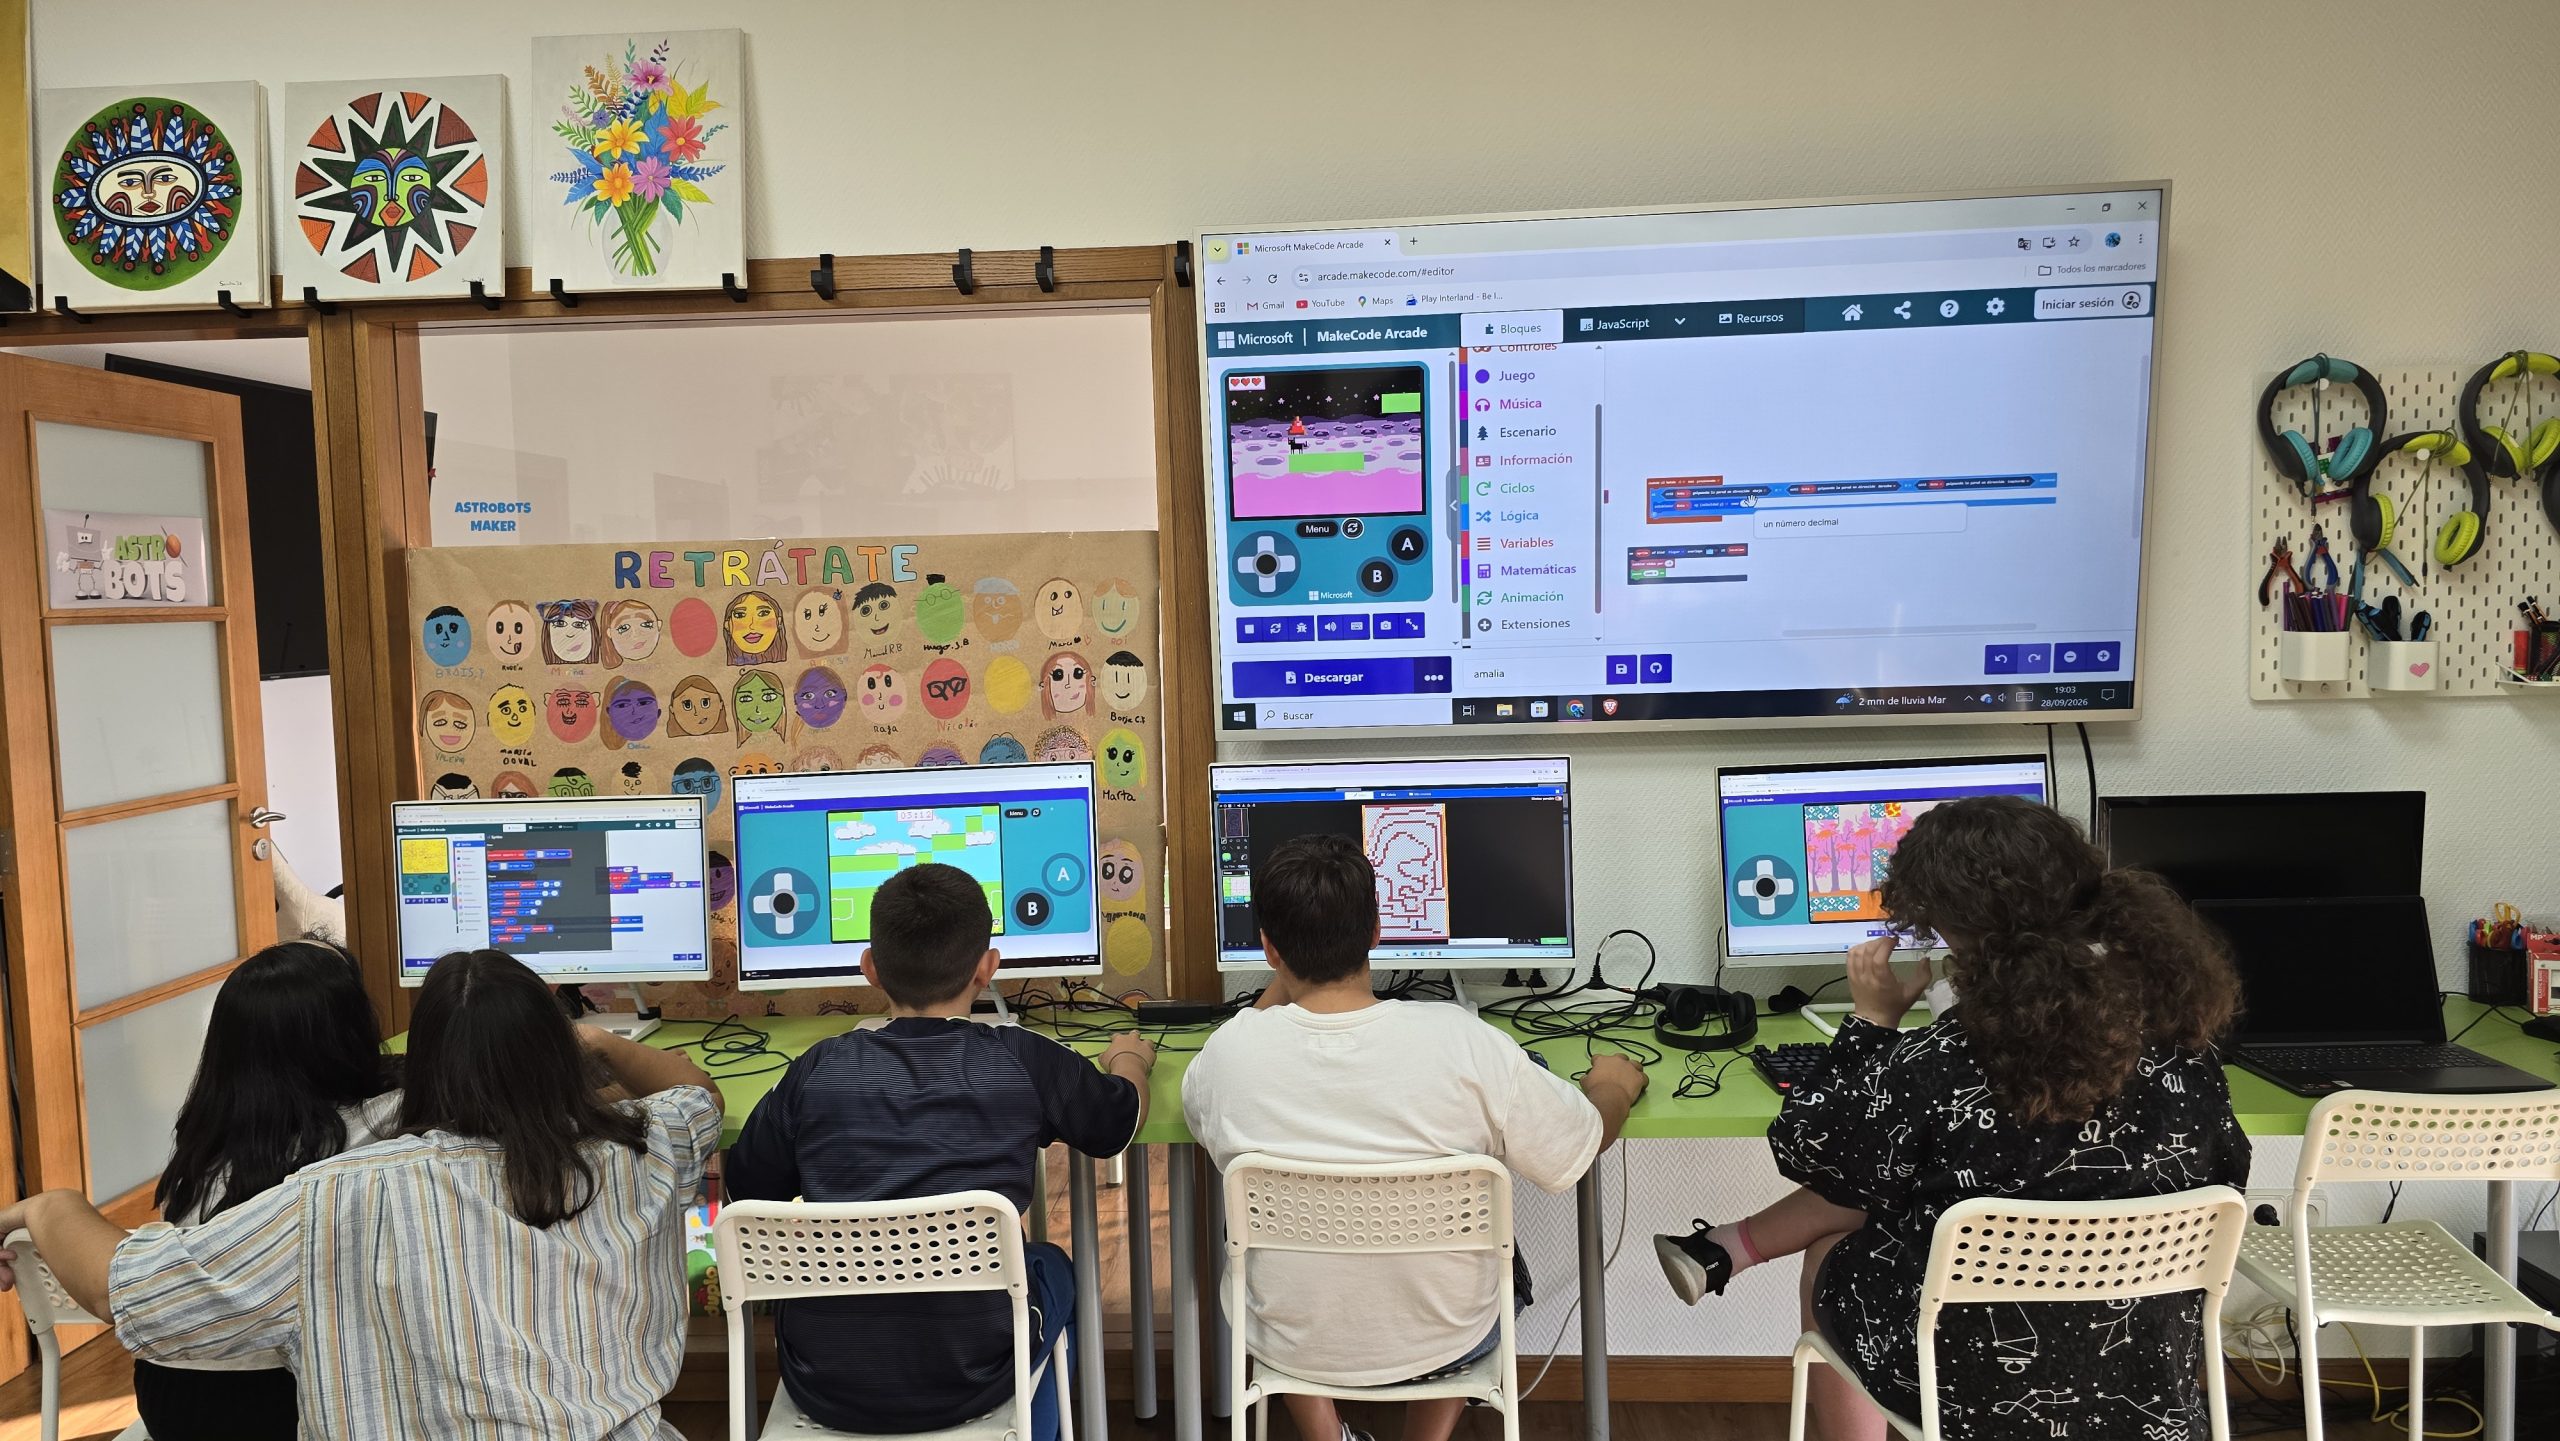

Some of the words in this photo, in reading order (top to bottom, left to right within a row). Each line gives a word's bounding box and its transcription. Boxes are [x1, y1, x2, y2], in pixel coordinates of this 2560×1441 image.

[1254, 242, 1292, 254] Microsoft
[1293, 241, 1334, 253] MakeCode
[1336, 239, 1364, 251] Arcade
[1317, 266, 1455, 281] arcade.makecode.com/#editor
[2057, 265, 2081, 275] Todos
[2083, 264, 2095, 274] los
[2097, 262, 2146, 273] marcadores
[1262, 300, 1285, 311] Gmail
[1311, 298, 1345, 309] YouTube
[1372, 295, 1394, 308] Maps
[1421, 295, 1437, 304] Play
[1440, 292, 1474, 302] Interland
[1482, 292, 1492, 300] Be
[2041, 298, 2076, 311] Iniciar
[2078, 296, 2114, 309] sesión
[1597, 317, 1650, 332] JavaScript
[1737, 311, 1784, 324] Recursos
[1317, 328, 1382, 342] MakeCode
[1384, 325, 1428, 340] Arcade
[1500, 322, 1542, 338] Bloques
[1237, 330, 1294, 346] Microsoft
[1499, 369, 1536, 385] Juego
[1499, 396, 1542, 411] Música
[1499, 424, 1557, 439] Escenario
[1499, 451, 1574, 467] Información
[1500, 481, 1535, 495] Ciclos
[455, 502, 532, 514] ASTROBOTS
[1500, 508, 1539, 524] Lógica
[1763, 520, 1774, 528] un
[1775, 518, 1806, 529] número
[1808, 517, 1839, 527] decimal
[470, 520, 516, 532] MAKER
[1305, 524, 1330, 534] Menu
[1401, 537, 1414, 551] A
[1500, 536, 1554, 551] Variables
[615, 539, 919, 589] RETRÁTATE
[1500, 563, 1577, 578] Matemáticas
[103, 555, 187, 602] BOTS
[1373, 569, 1383, 584] B
[1320, 589, 1353, 600] Microsoft
[1500, 590, 1564, 605] Animación
[1500, 617, 1571, 632] Extensiones
[1304, 671, 1364, 687] Descargar
[1473, 668, 1505, 679] amalia
[2054, 685, 2076, 695] 19:03
[1859, 696, 1865, 706] 2
[1867, 697, 1883, 706] mm
[1886, 696, 1900, 706] de
[1901, 694, 1928, 706] lluvia
[1930, 694, 1946, 705] Mar
[2041, 697, 2088, 707] 28/09/2026
[1282, 710, 1314, 722] Buscar
[1102, 789, 1137, 802] Marta
[1057, 867, 1070, 882] A
[1028, 902, 1039, 916] B
[703, 1266, 721, 1317] duplo
